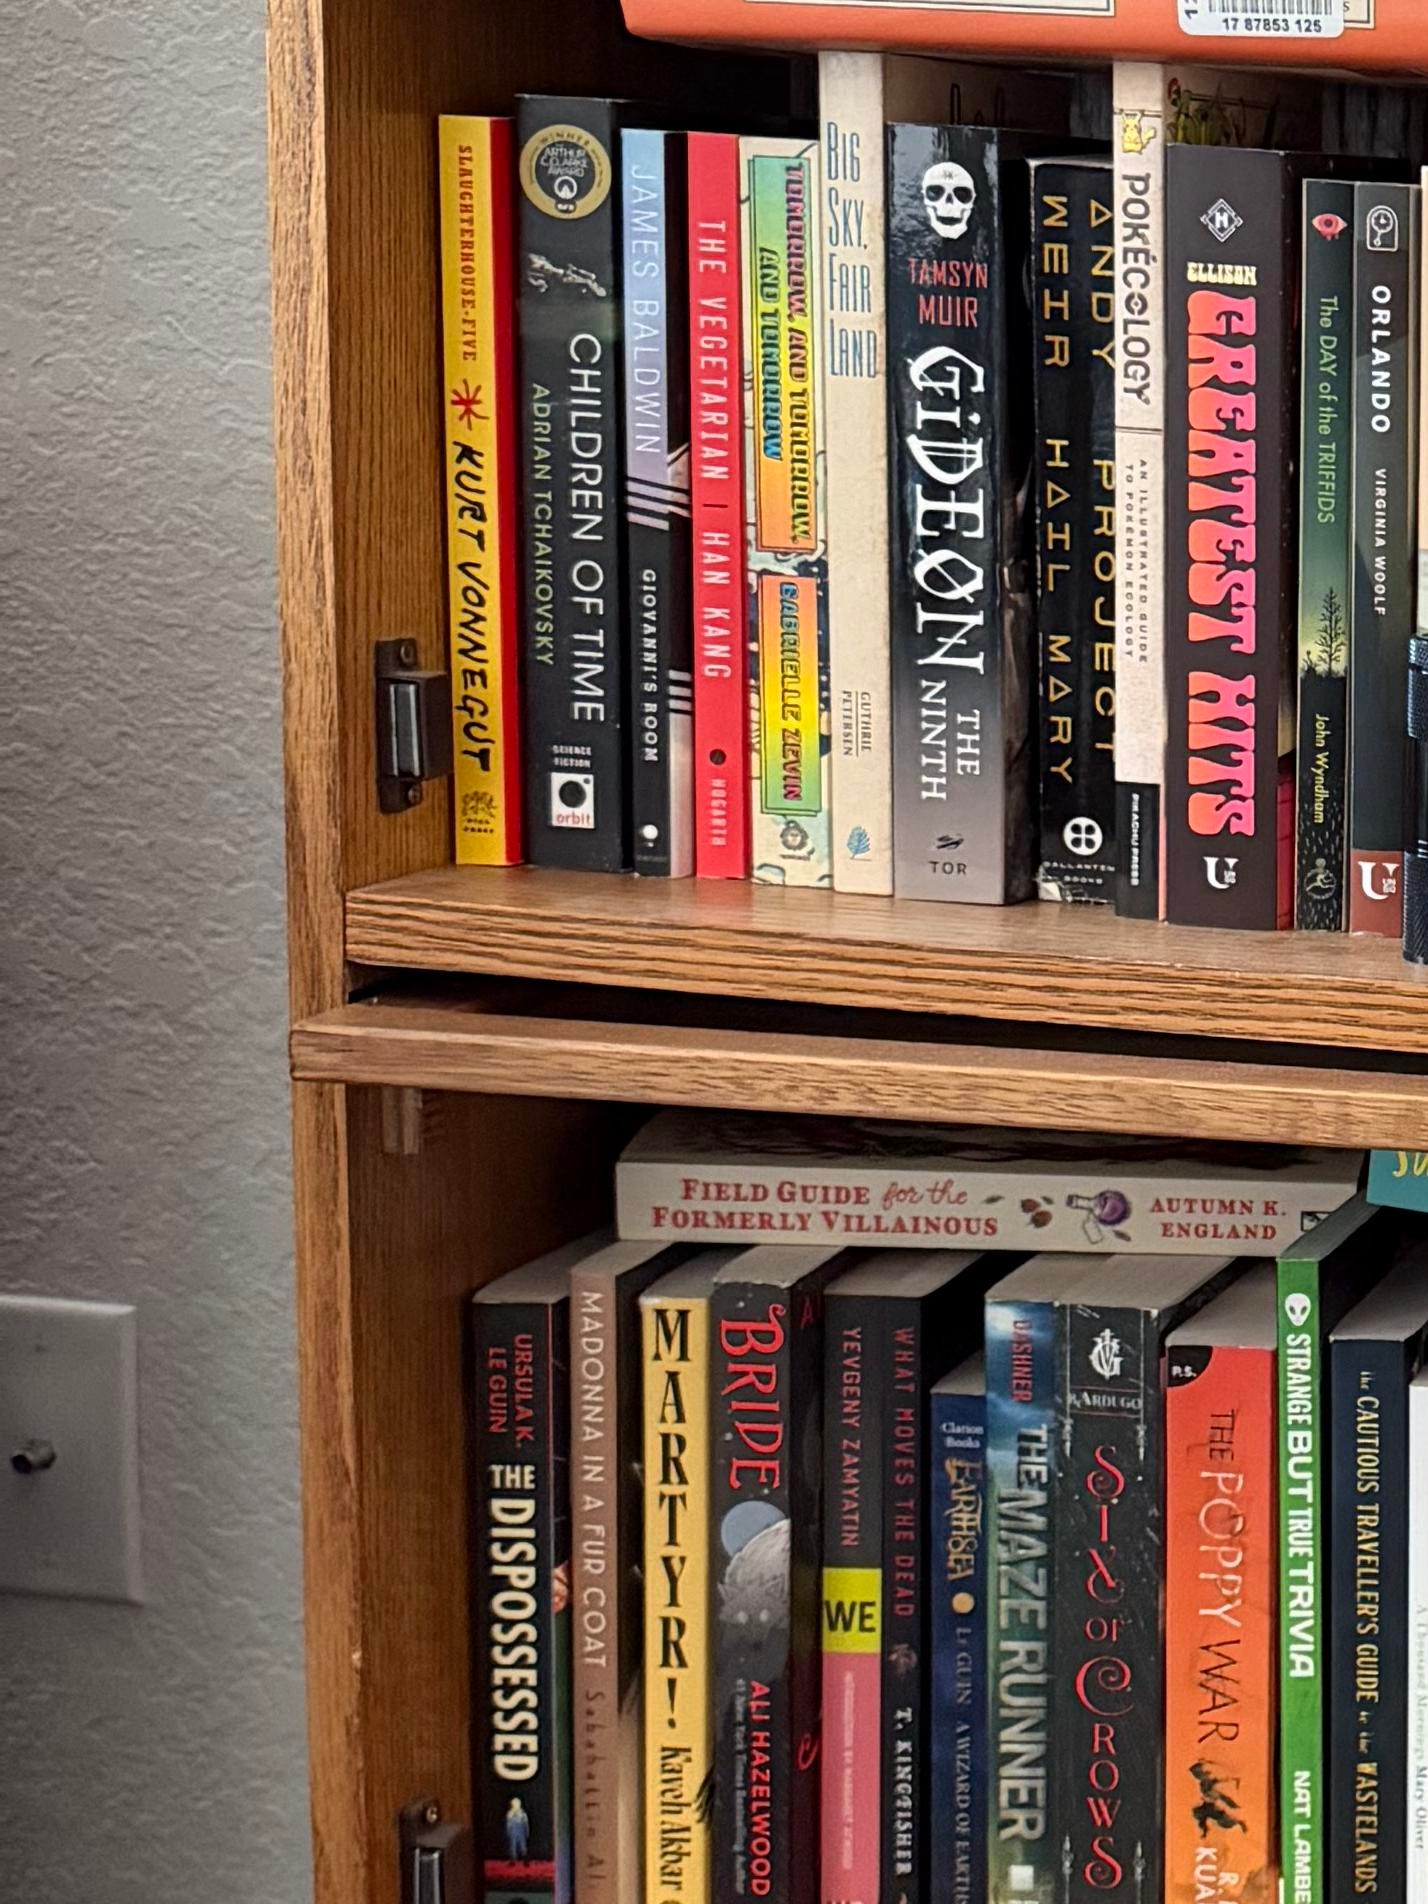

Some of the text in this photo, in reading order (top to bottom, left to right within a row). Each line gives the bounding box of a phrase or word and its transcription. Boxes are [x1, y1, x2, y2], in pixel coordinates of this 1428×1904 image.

[1222, 19, 1321, 32] 17 87853 125
[909, 259, 988, 288] TAMSYN
[1187, 264, 1256, 285] ELLISON
[919, 294, 978, 327] MUIR
[569, 334, 604, 723] CHILDREN OF TIME
[1186, 290, 1256, 838] GREATEST HITS
[453, 442, 491, 771] KURT VONNEGUT
[930, 860, 968, 875] TOR
[683, 1179, 967, 1210] FIELD GUIDE for the
[652, 1207, 997, 1236] FORMERLY VILLAINOUS
[719, 1303, 784, 1490] BRIDE
[653, 1309, 691, 1728] MARTYR!
[1286, 1333, 1315, 1679] STRANGE BUT TRUE TRIVIA
[490, 1466, 538, 1781] THE DISPOSSESSED
[826, 1600, 876, 1632] WE
